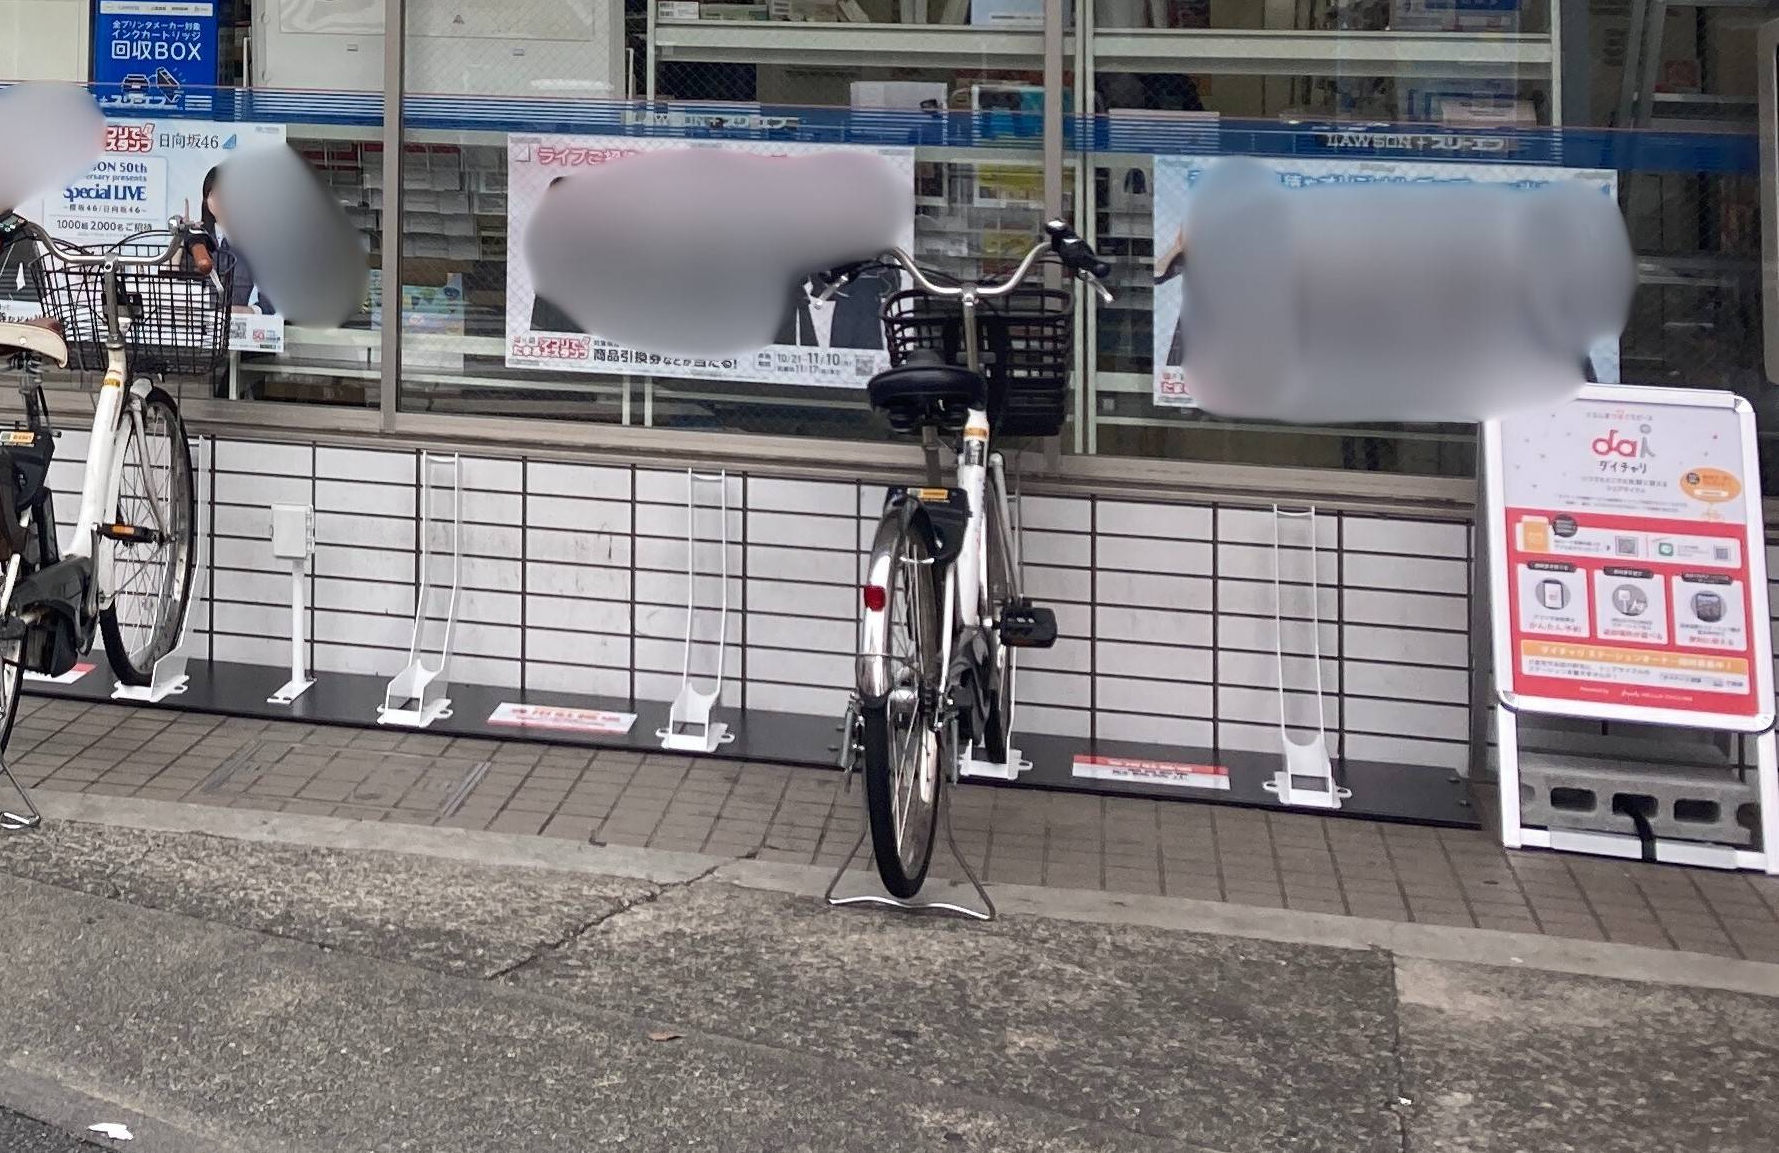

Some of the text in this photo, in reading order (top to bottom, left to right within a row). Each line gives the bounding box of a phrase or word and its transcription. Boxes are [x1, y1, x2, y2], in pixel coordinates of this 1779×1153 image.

[112, 19, 201, 31] 全プリンタメーカー対象
[112, 29, 201, 41] インクカートリッジ
[111, 40, 202, 61] 回収BOX
[159, 133, 219, 149] 日向坂46
[1326, 133, 1412, 149] LAWSON
[538, 147, 637, 166] ライブご招
[119, 161, 147, 174] 50th
[112, 174, 147, 184] presents
[114, 186, 147, 201] LIVE
[1598, 460, 1648, 474] ダイチャリ
